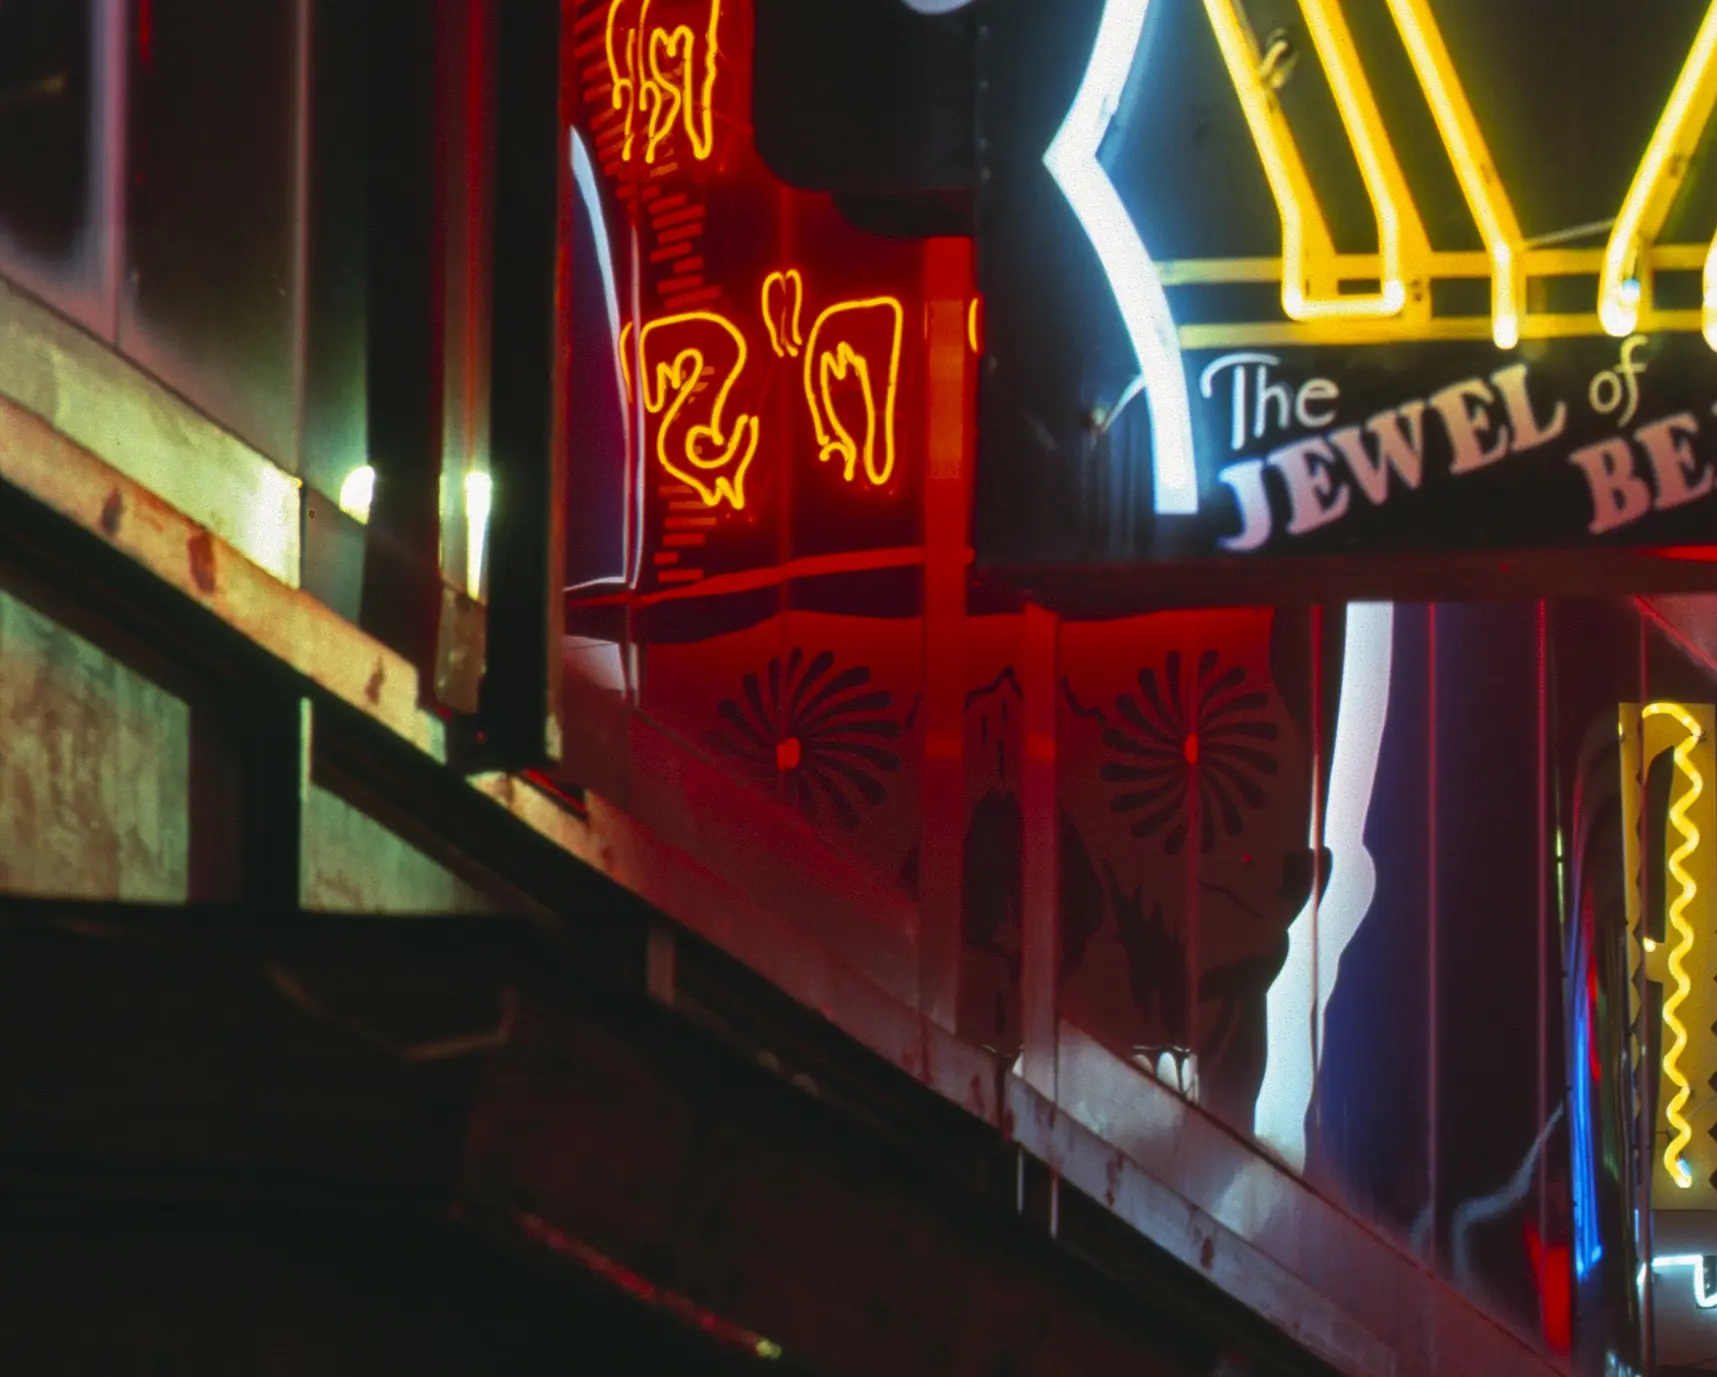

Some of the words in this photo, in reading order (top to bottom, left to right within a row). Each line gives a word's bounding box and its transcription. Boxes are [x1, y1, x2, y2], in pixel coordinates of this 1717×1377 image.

[1202, 354, 1339, 450] The
[1218, 362, 1567, 552] JEWEL
[1589, 334, 1648, 426] of
